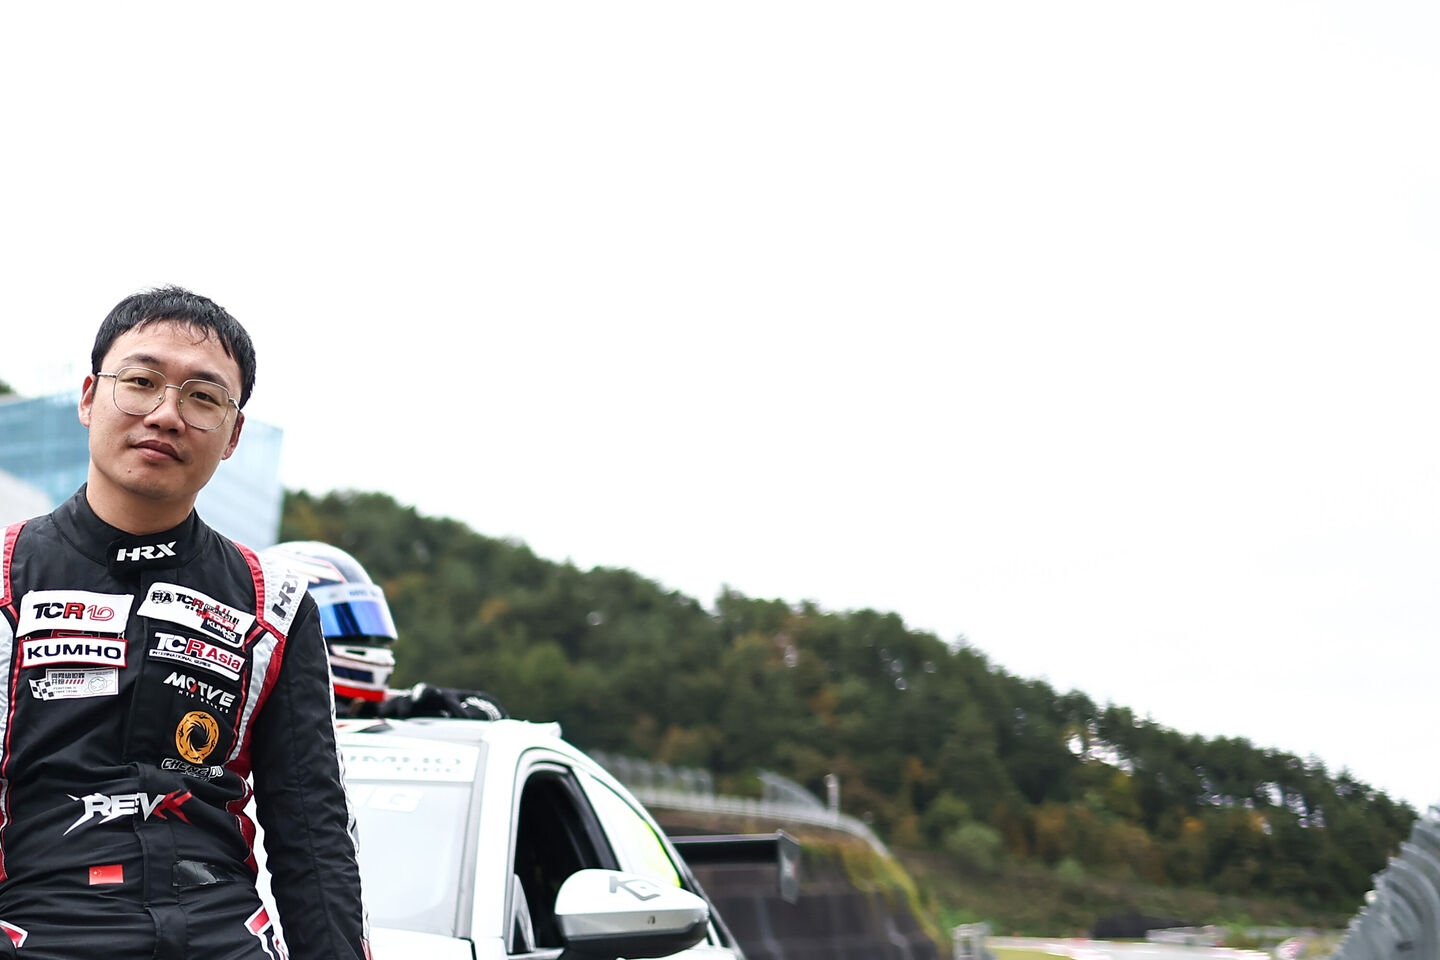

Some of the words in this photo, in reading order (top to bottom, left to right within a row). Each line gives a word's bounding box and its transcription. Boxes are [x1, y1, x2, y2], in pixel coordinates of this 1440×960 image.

[116, 541, 177, 561] HRX
[27, 644, 122, 660] KUMHO
[155, 632, 206, 658] TCR
[206, 647, 241, 671] Asia
